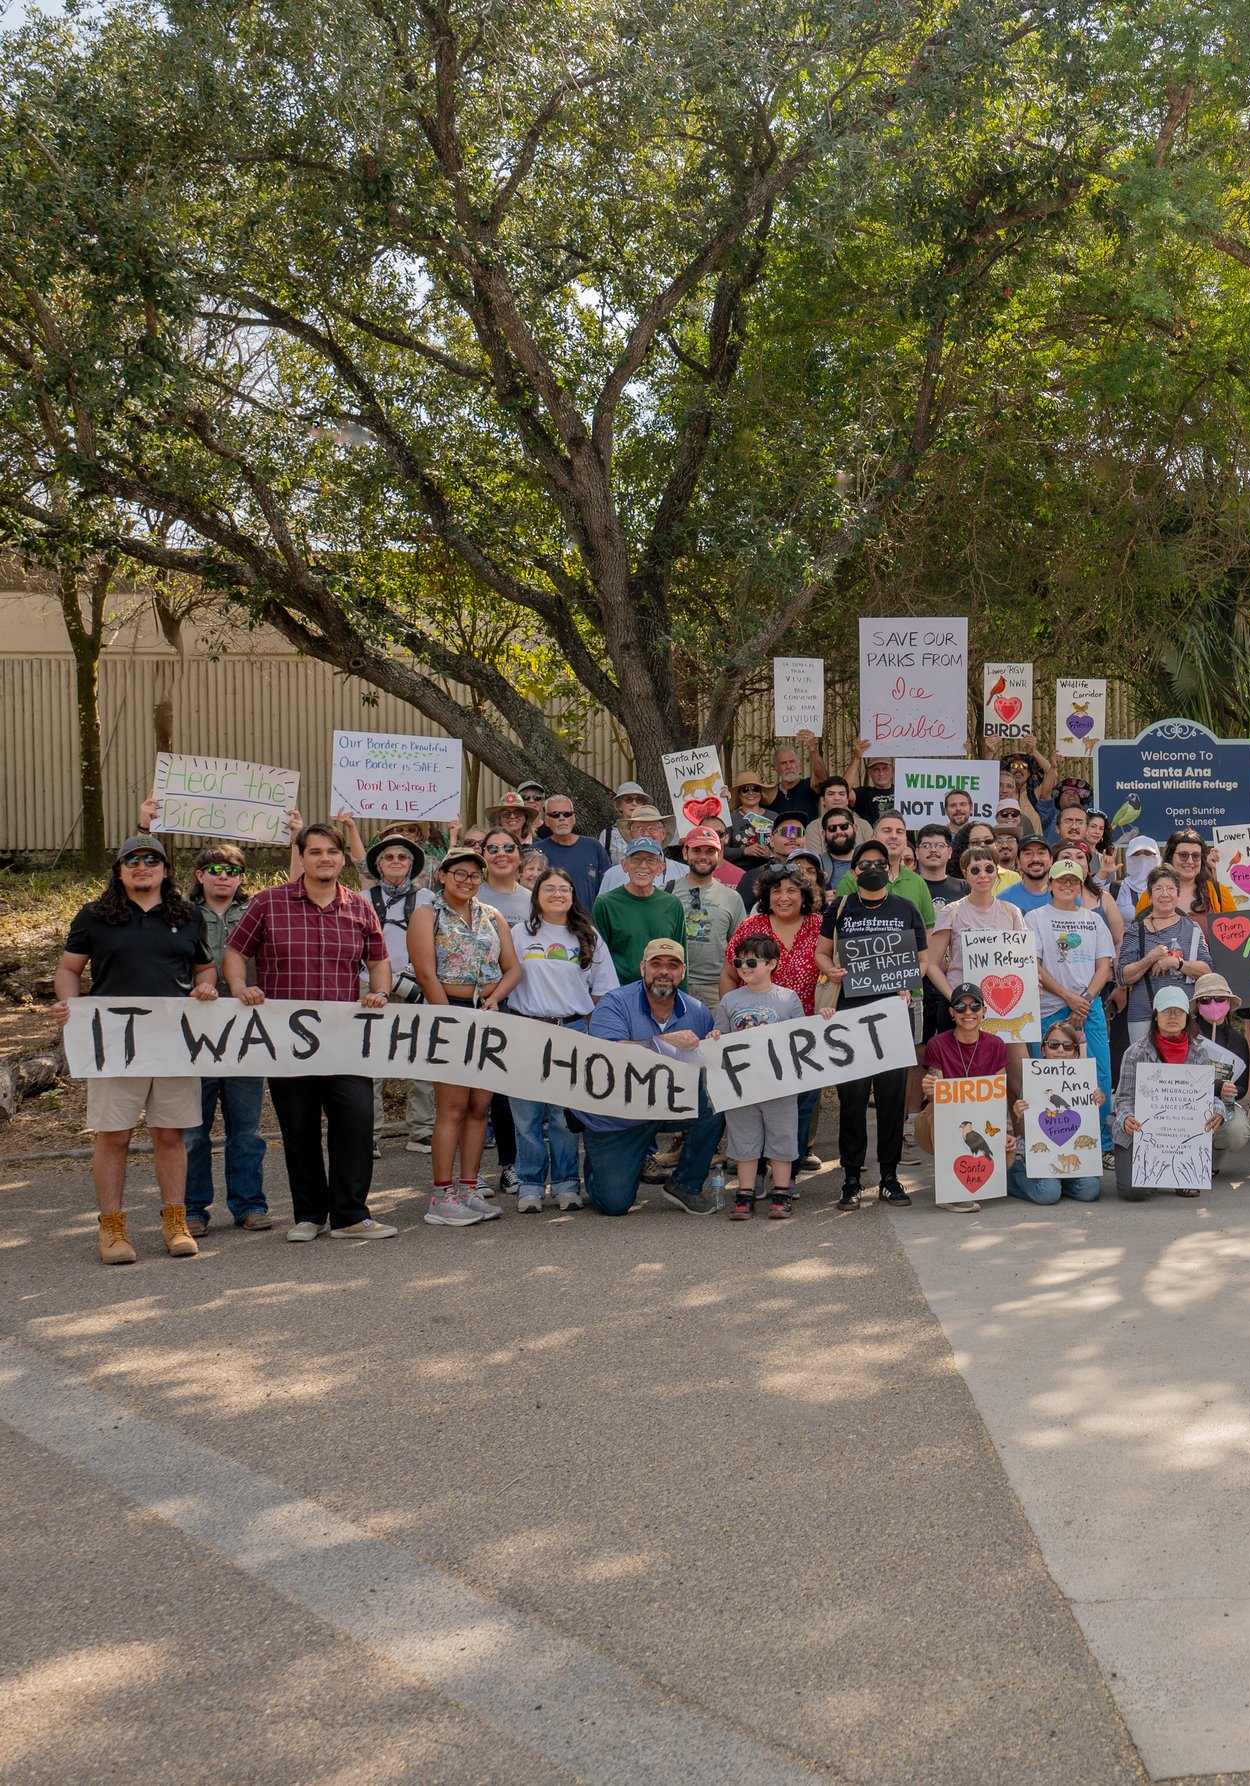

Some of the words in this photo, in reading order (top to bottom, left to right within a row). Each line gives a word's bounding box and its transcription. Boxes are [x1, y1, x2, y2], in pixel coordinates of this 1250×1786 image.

[873, 632, 918, 647] SAVE
[924, 632, 957, 646] OUR
[867, 652, 915, 667] PARKS
[922, 652, 963, 667] FROM
[987, 666, 1006, 675] Lower
[1007, 665, 1025, 674] RGV
[892, 676, 934, 700] Ice
[1009, 680, 1028, 688] NWR
[1060, 680, 1089, 688] Wildlife
[1073, 690, 1103, 699] Corridor
[782, 715, 818, 723] DIVIDIR
[1069, 721, 1094, 729] Friends
[872, 713, 957, 740] Barbie
[985, 723, 1031, 738] BIRDS
[339, 736, 362, 749] Our
[367, 737, 399, 749] Border
[410, 742, 448, 753] Beautiful
[664, 753, 689, 765] Santa
[691, 750, 710, 762] Ana
[1141, 751, 1197, 761] Welcome
[1199, 751, 1213, 761] To
[339, 756, 361, 768] Our
[365, 758, 397, 770] Border
[413, 761, 440, 773] SAFE
[675, 762, 706, 779] NWR
[1143, 767, 1182, 777] Santa
[1184, 767, 1212, 777] Ana
[166, 759, 238, 794] Hear
[244, 769, 288, 803] the
[388, 780, 425, 793] Destroy
[428, 782, 437, 793] It
[905, 773, 980, 790] WILDLIFE
[1116, 780, 1160, 790] National
[1162, 780, 1201, 789] Wildlife
[1202, 780, 1238, 791] Refuge
[360, 798, 375, 810] for
[381, 803, 388, 811] a
[396, 800, 419, 812] LIE
[900, 801, 934, 816] NOT
[1165, 807, 1190, 817] Open
[1192, 806, 1226, 815] Sunrise
[237, 810, 280, 842] cry
[1174, 818, 1184, 826] to
[1186, 817, 1216, 826] Sunset
[1215, 829, 1245, 844] Lower
[843, 916, 904, 928] Resistencia
[1217, 922, 1243, 932] Thorn
[965, 934, 998, 947] Lower
[1002, 932, 1027, 944] RGV
[1220, 930, 1246, 941] Forest
[845, 933, 902, 959] STOP
[848, 960, 870, 974] THE
[876, 951, 916, 970] HATE!
[969, 952, 989, 970] NW
[994, 950, 1035, 968] Refuges
[851, 977, 872, 987] NO
[881, 968, 920, 982] BORDER
[872, 980, 906, 992] WALLS!
[91, 1006, 152, 1072] IT
[181, 1008, 322, 1064] WAS
[353, 1012, 508, 1073] THEIR
[541, 1036, 695, 1114] HOME
[721, 1012, 888, 1098] FIRST
[1031, 1060, 1077, 1076] Santa
[935, 1076, 1007, 1104] BIRDS
[1061, 1081, 1090, 1092] Ana
[1071, 1093, 1096, 1107] NWR
[1045, 1116, 1070, 1125] WILD
[1048, 1124, 1079, 1136] Friends
[960, 1160, 986, 1174] Santa
[966, 1175, 982, 1185] Ana
